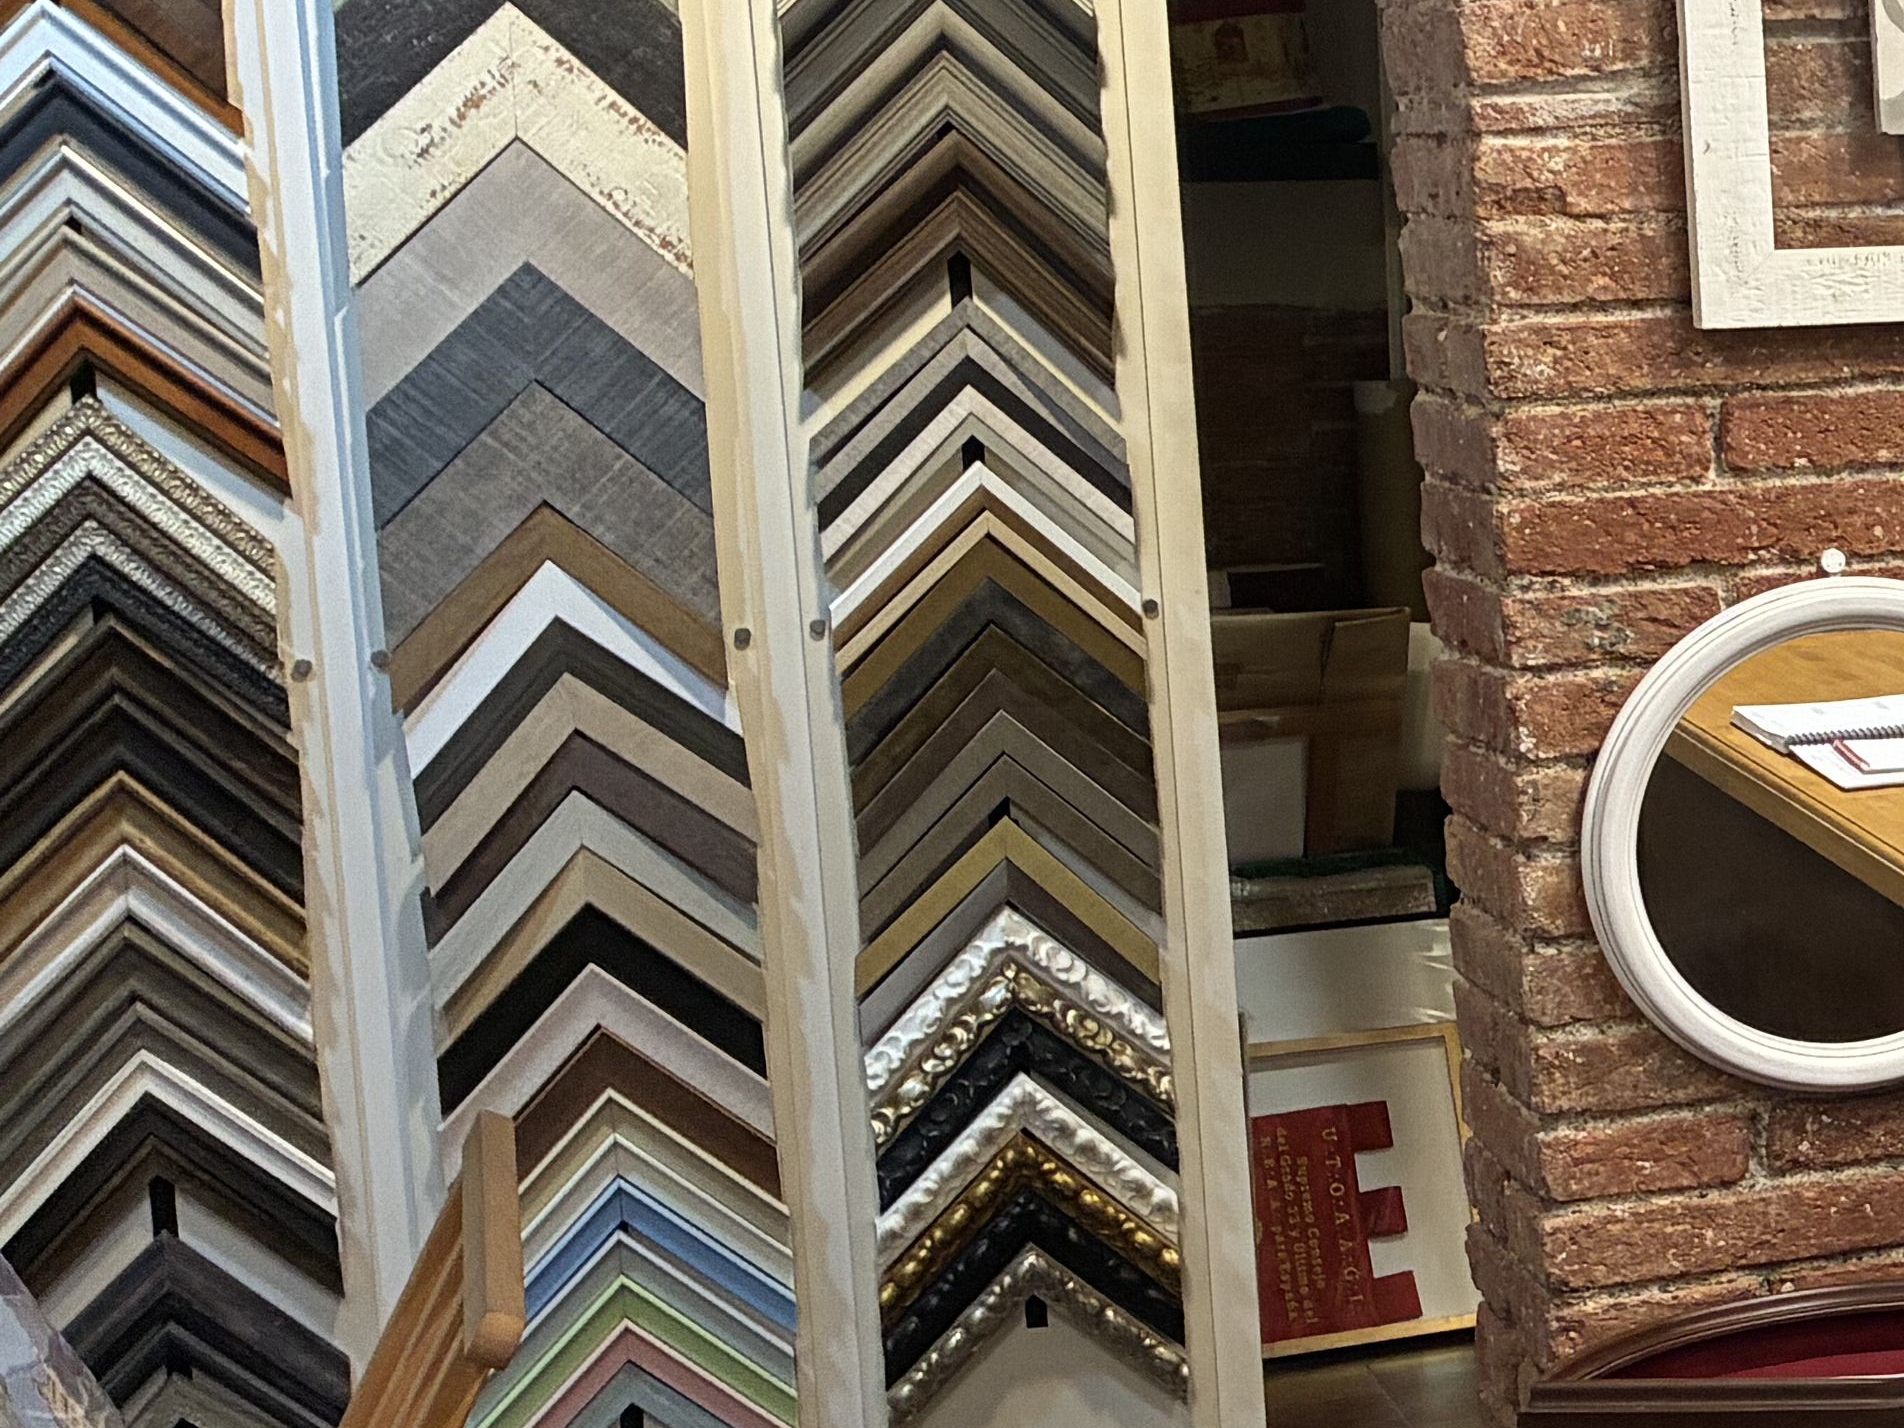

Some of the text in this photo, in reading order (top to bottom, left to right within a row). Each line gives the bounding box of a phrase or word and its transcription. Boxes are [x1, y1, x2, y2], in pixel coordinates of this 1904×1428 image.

[1276, 1127, 1289, 1152] del
[1280, 1155, 1295, 1200] Grado
[1295, 1156, 1326, 1289] Supremo Consejo
[1303, 1299, 1319, 1325] del
